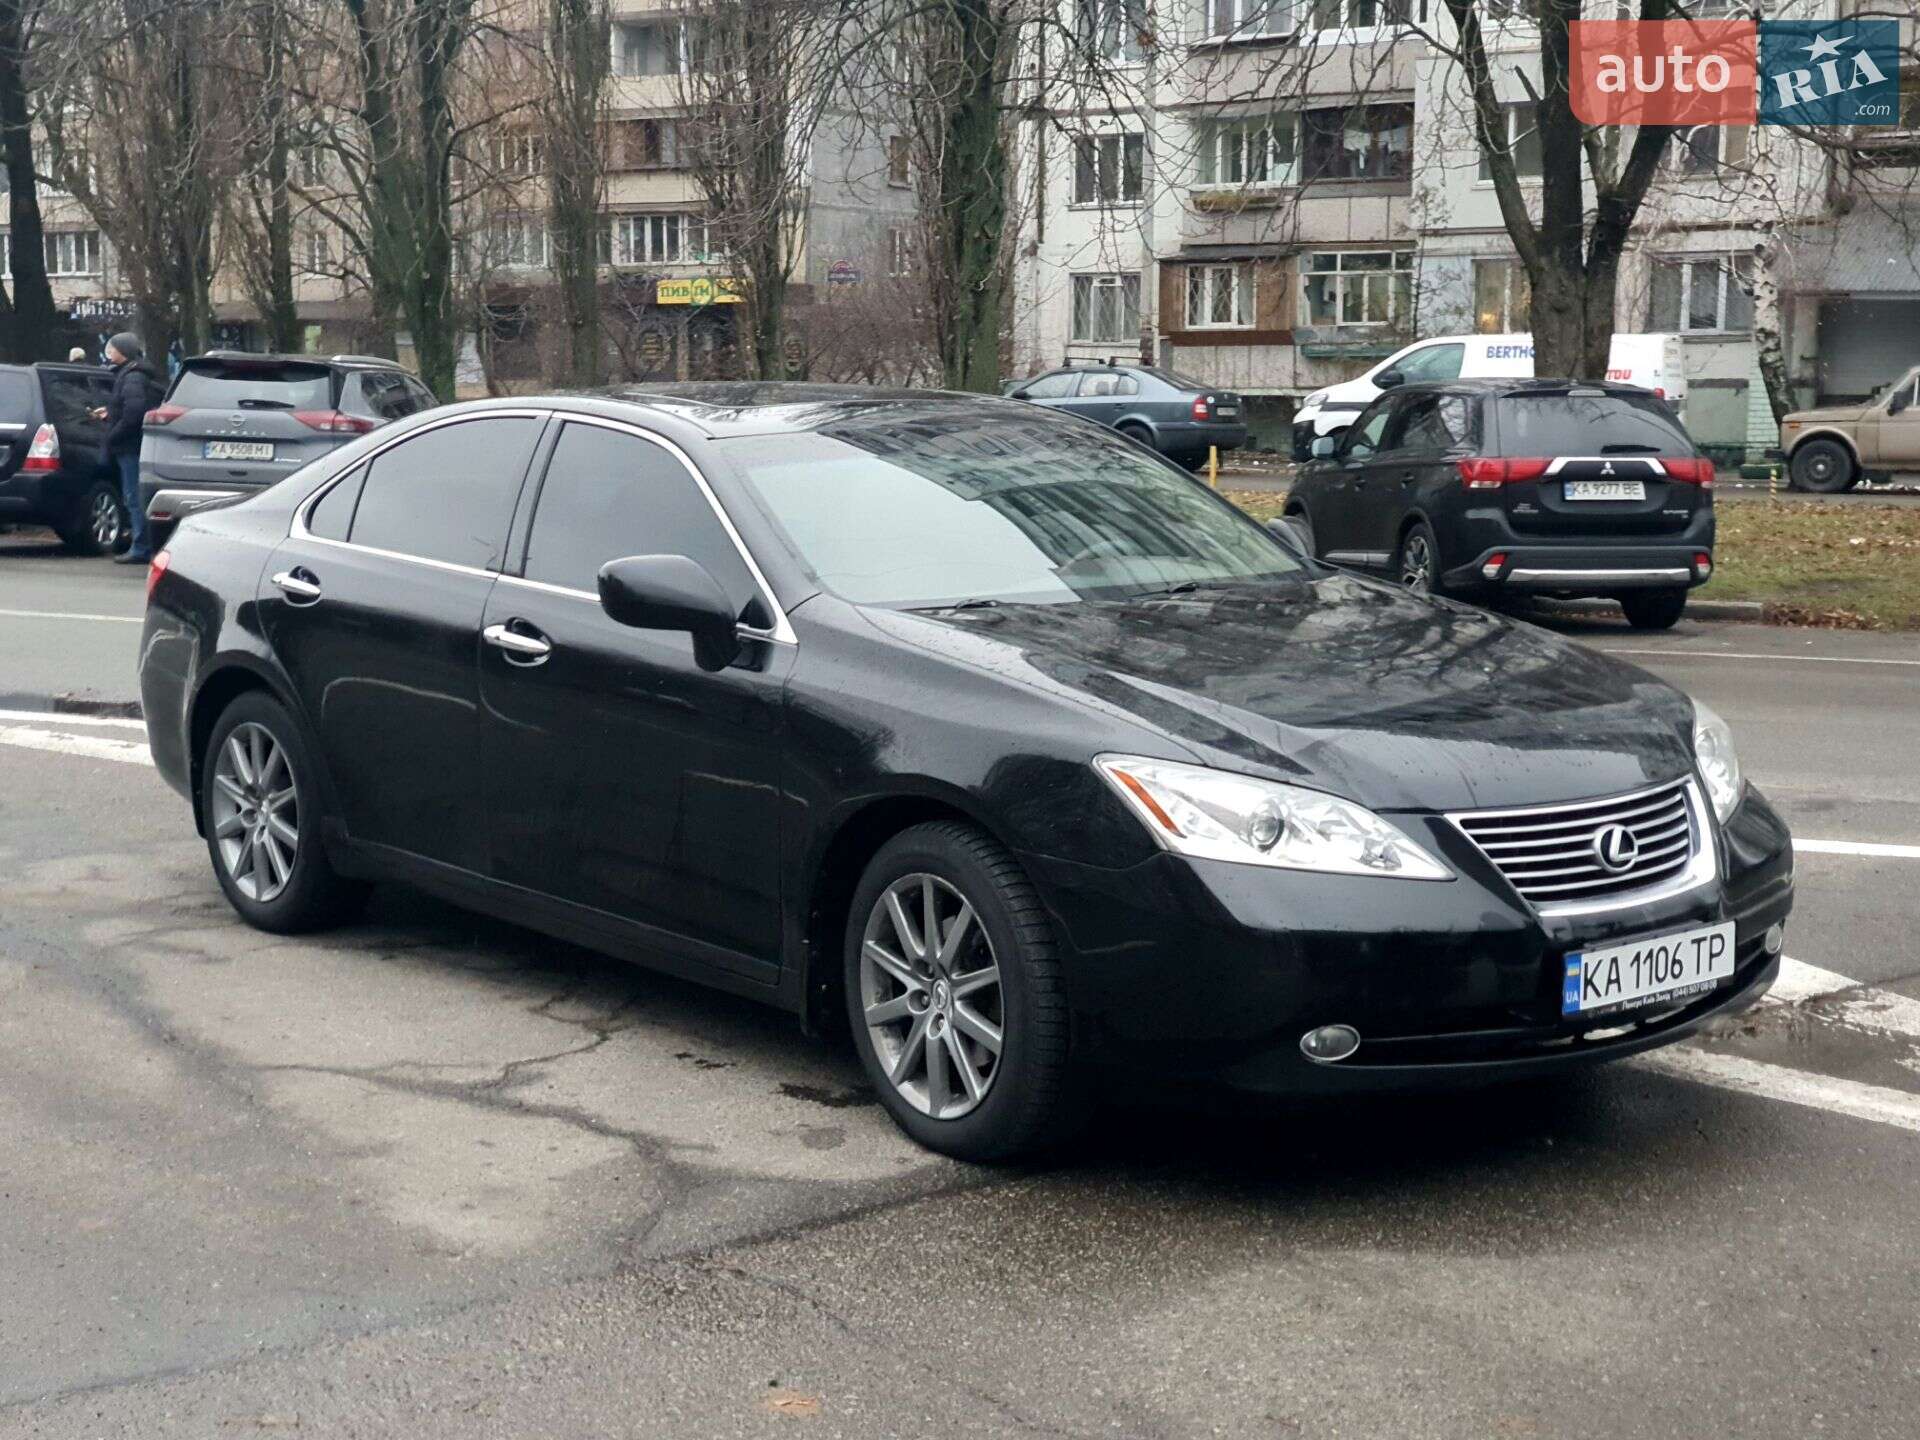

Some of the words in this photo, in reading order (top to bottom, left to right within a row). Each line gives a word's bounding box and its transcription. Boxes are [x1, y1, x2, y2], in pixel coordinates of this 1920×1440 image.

[1574, 482, 1591, 495] KA
[1593, 482, 1620, 495] 9277
[1583, 956, 1622, 1000] KA
[1630, 942, 1684, 989] 1106
[1691, 933, 1725, 975] TP
[1565, 991, 1579, 1004] UA
